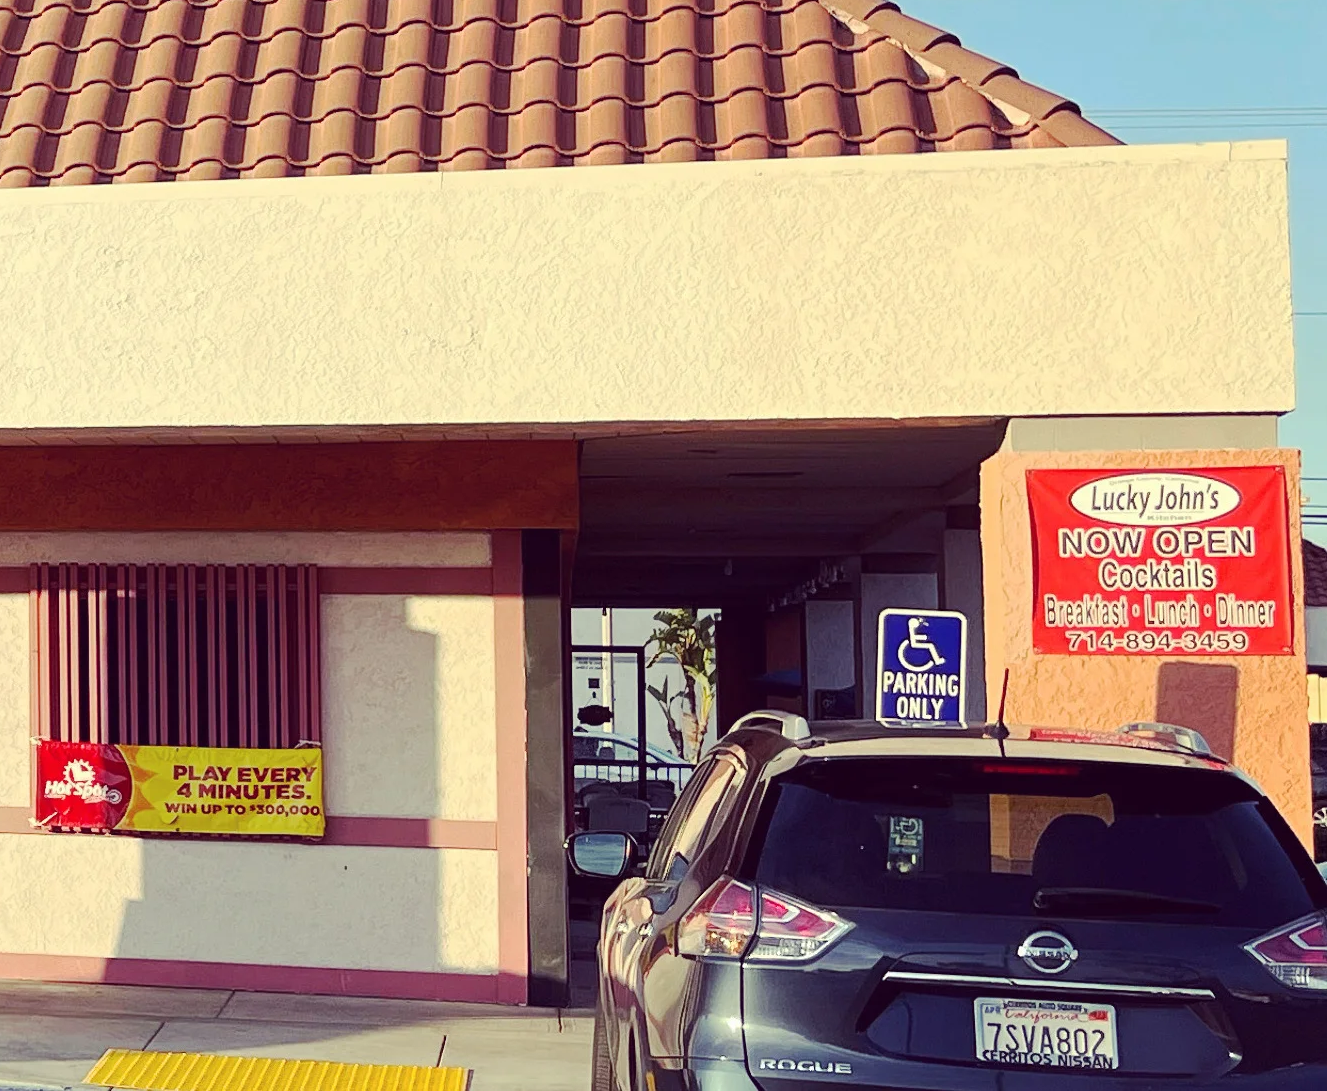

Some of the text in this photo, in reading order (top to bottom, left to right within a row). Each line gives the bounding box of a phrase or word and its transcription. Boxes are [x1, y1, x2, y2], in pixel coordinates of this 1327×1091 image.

[1091, 482, 1220, 518] Lucky John's
[1061, 529, 1253, 556] NOW OPEN
[1101, 560, 1215, 589] Cocktails
[1046, 596, 1276, 626] Breakfast Lunch Dinner
[1068, 632, 1248, 651] 714-894-3459
[883, 671, 959, 697] PARKING
[896, 696, 944, 720] ONLY
[173, 764, 317, 783] PLAY EVERY
[176, 782, 312, 800] 4 MINUTES.
[164, 802, 197, 815] WIN
[201, 803, 223, 815] UP
[224, 804, 247, 816] TO
[1004, 1008, 1079, 1024] California
[987, 1022, 1106, 1056] 7SVA802
[759, 1058, 853, 1075] ROGUE
[982, 1049, 1114, 1069] CERRITOS NISSAN
